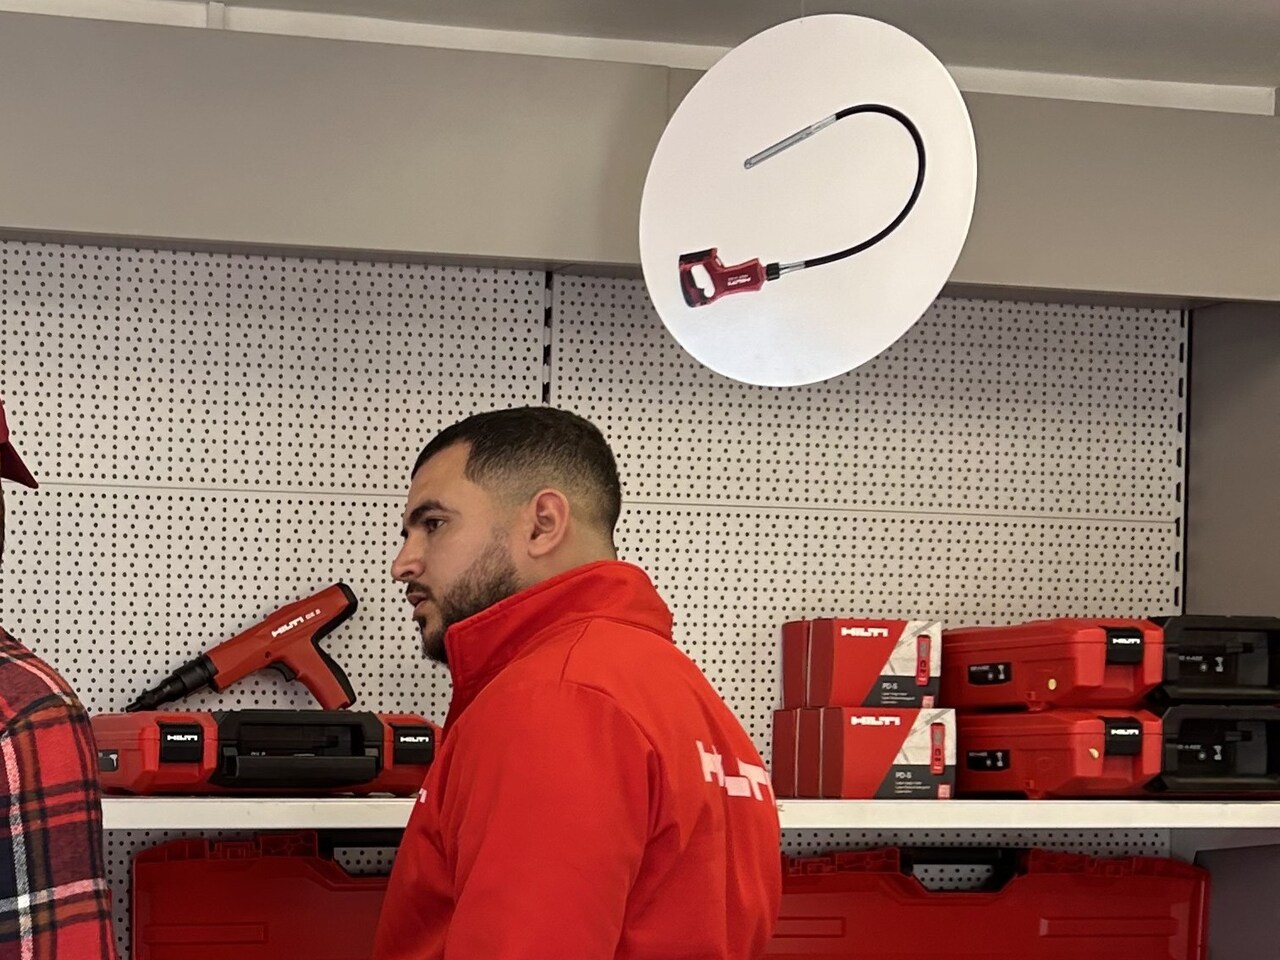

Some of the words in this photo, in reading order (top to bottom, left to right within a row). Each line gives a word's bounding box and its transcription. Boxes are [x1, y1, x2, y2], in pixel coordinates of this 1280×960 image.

[271, 616, 304, 638] HILTI
[841, 627, 889, 637] HILTI
[851, 716, 901, 726] HILTI
